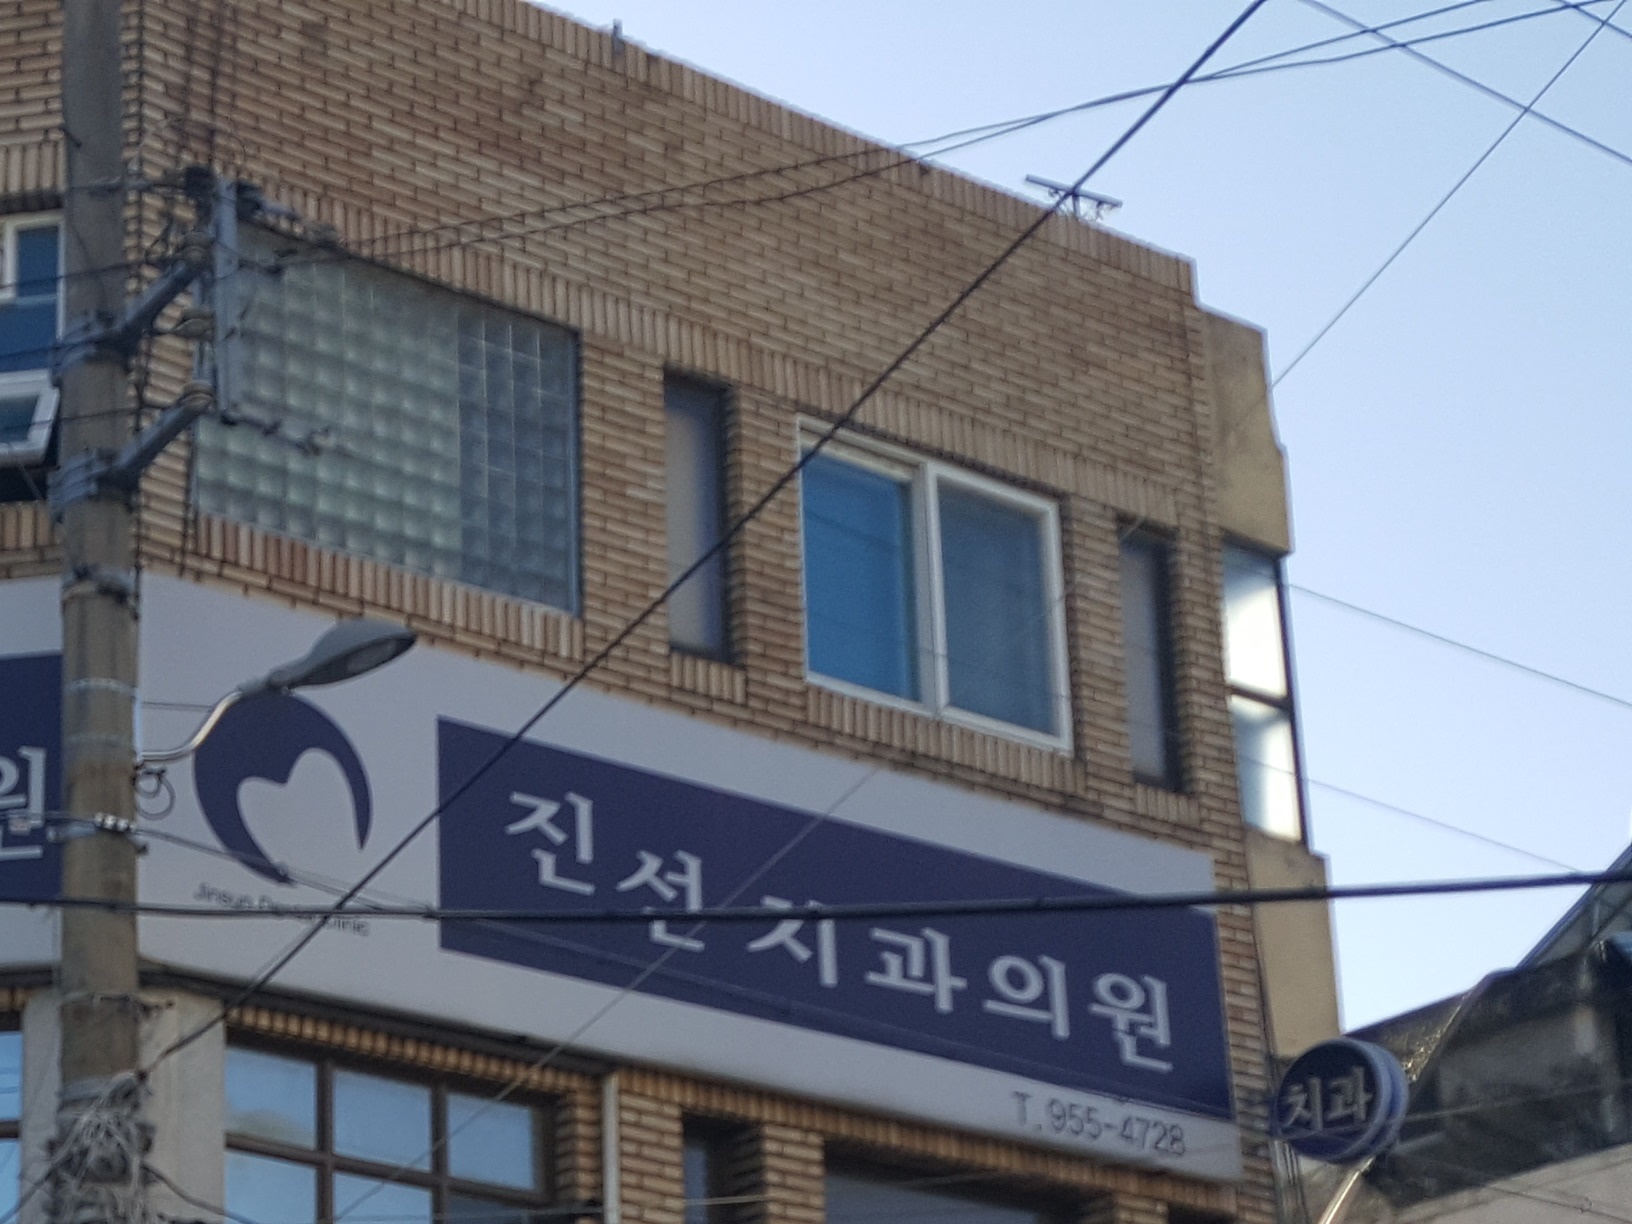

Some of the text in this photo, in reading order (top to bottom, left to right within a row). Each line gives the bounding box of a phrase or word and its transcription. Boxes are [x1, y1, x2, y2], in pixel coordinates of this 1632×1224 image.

[504, 791, 1173, 1074] 진선치과의원
[1012, 1089, 1187, 1157] T.955-4728
[1283, 1066, 1374, 1136] 치과
